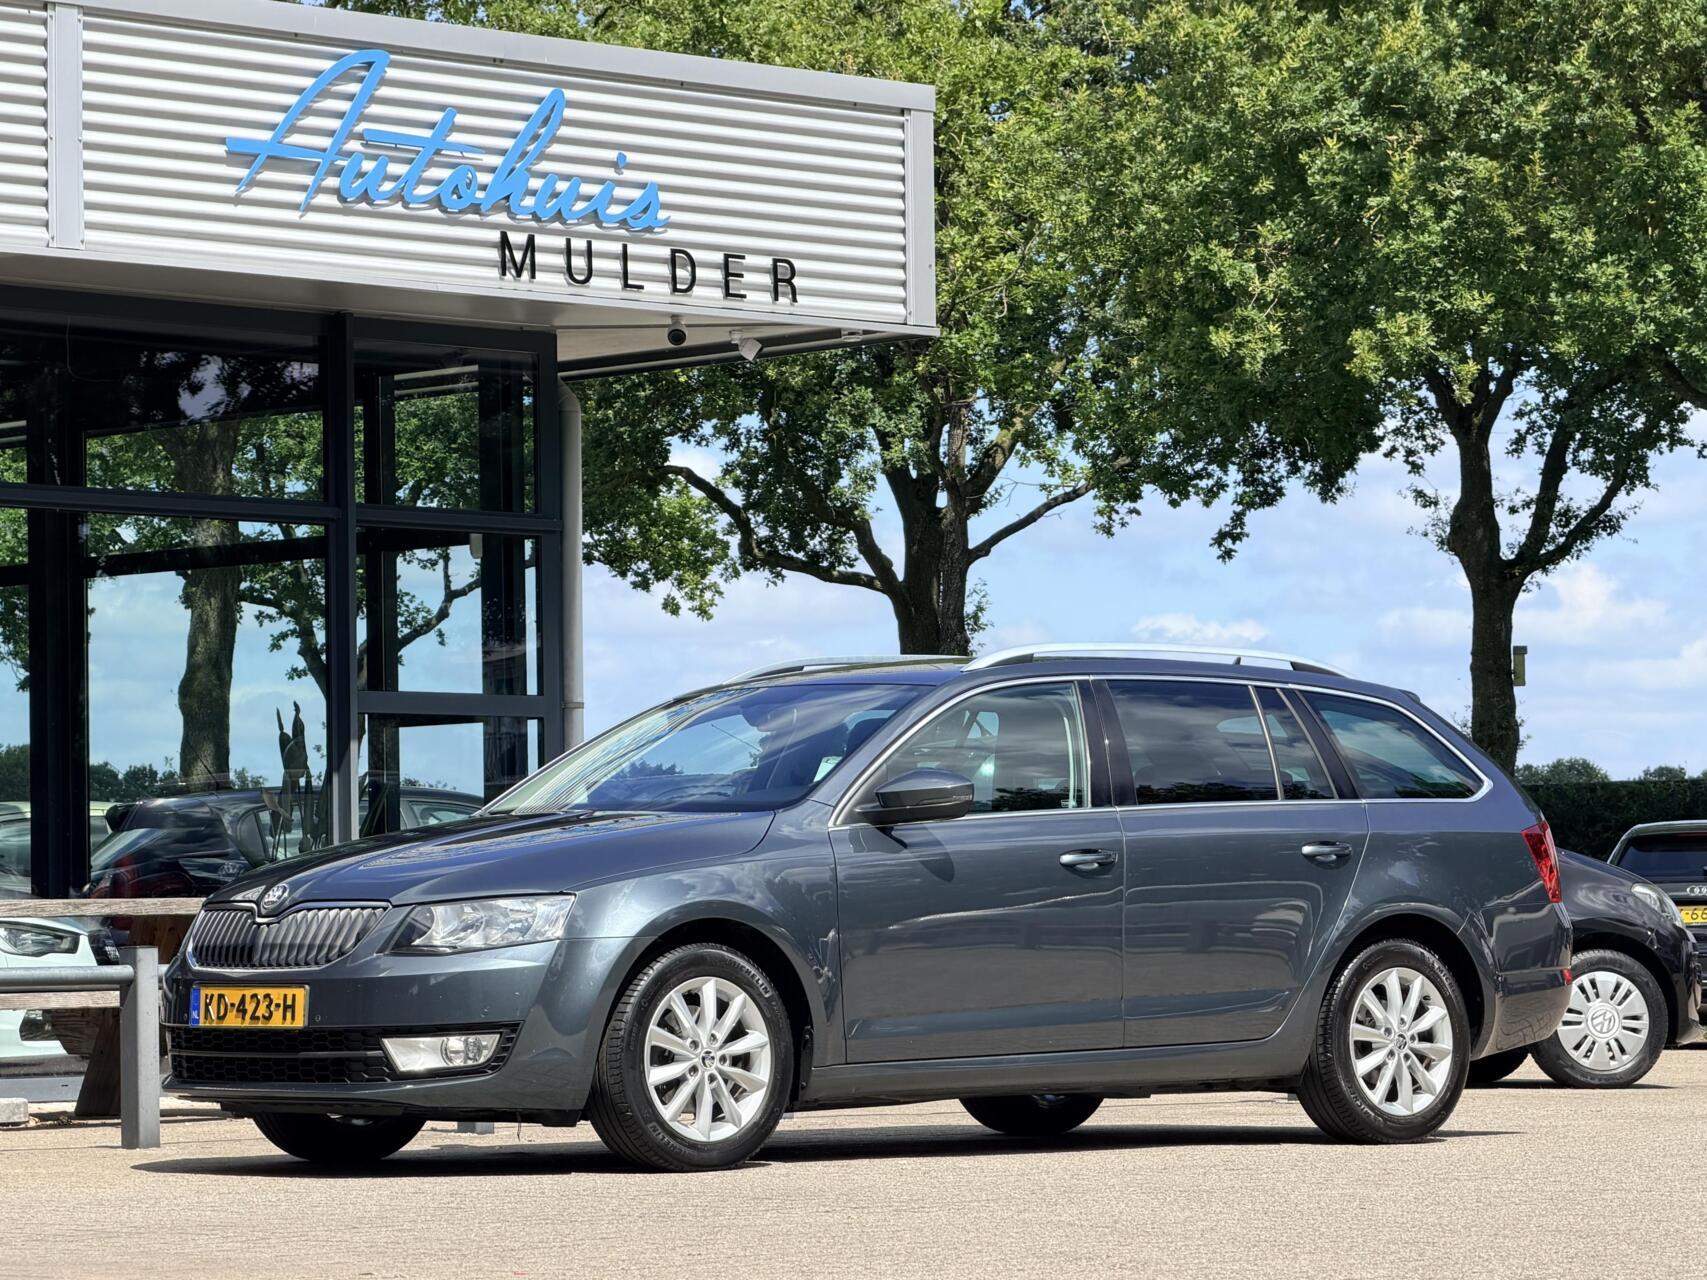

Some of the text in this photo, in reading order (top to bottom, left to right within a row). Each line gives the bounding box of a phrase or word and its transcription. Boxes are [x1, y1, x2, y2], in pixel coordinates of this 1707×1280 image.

[226, 49, 670, 229] Autohuis
[500, 231, 798, 303] MULDER
[1680, 907, 1707, 921] -66
[192, 1010, 200, 1020] NL
[204, 993, 297, 1022] KD-423-H
